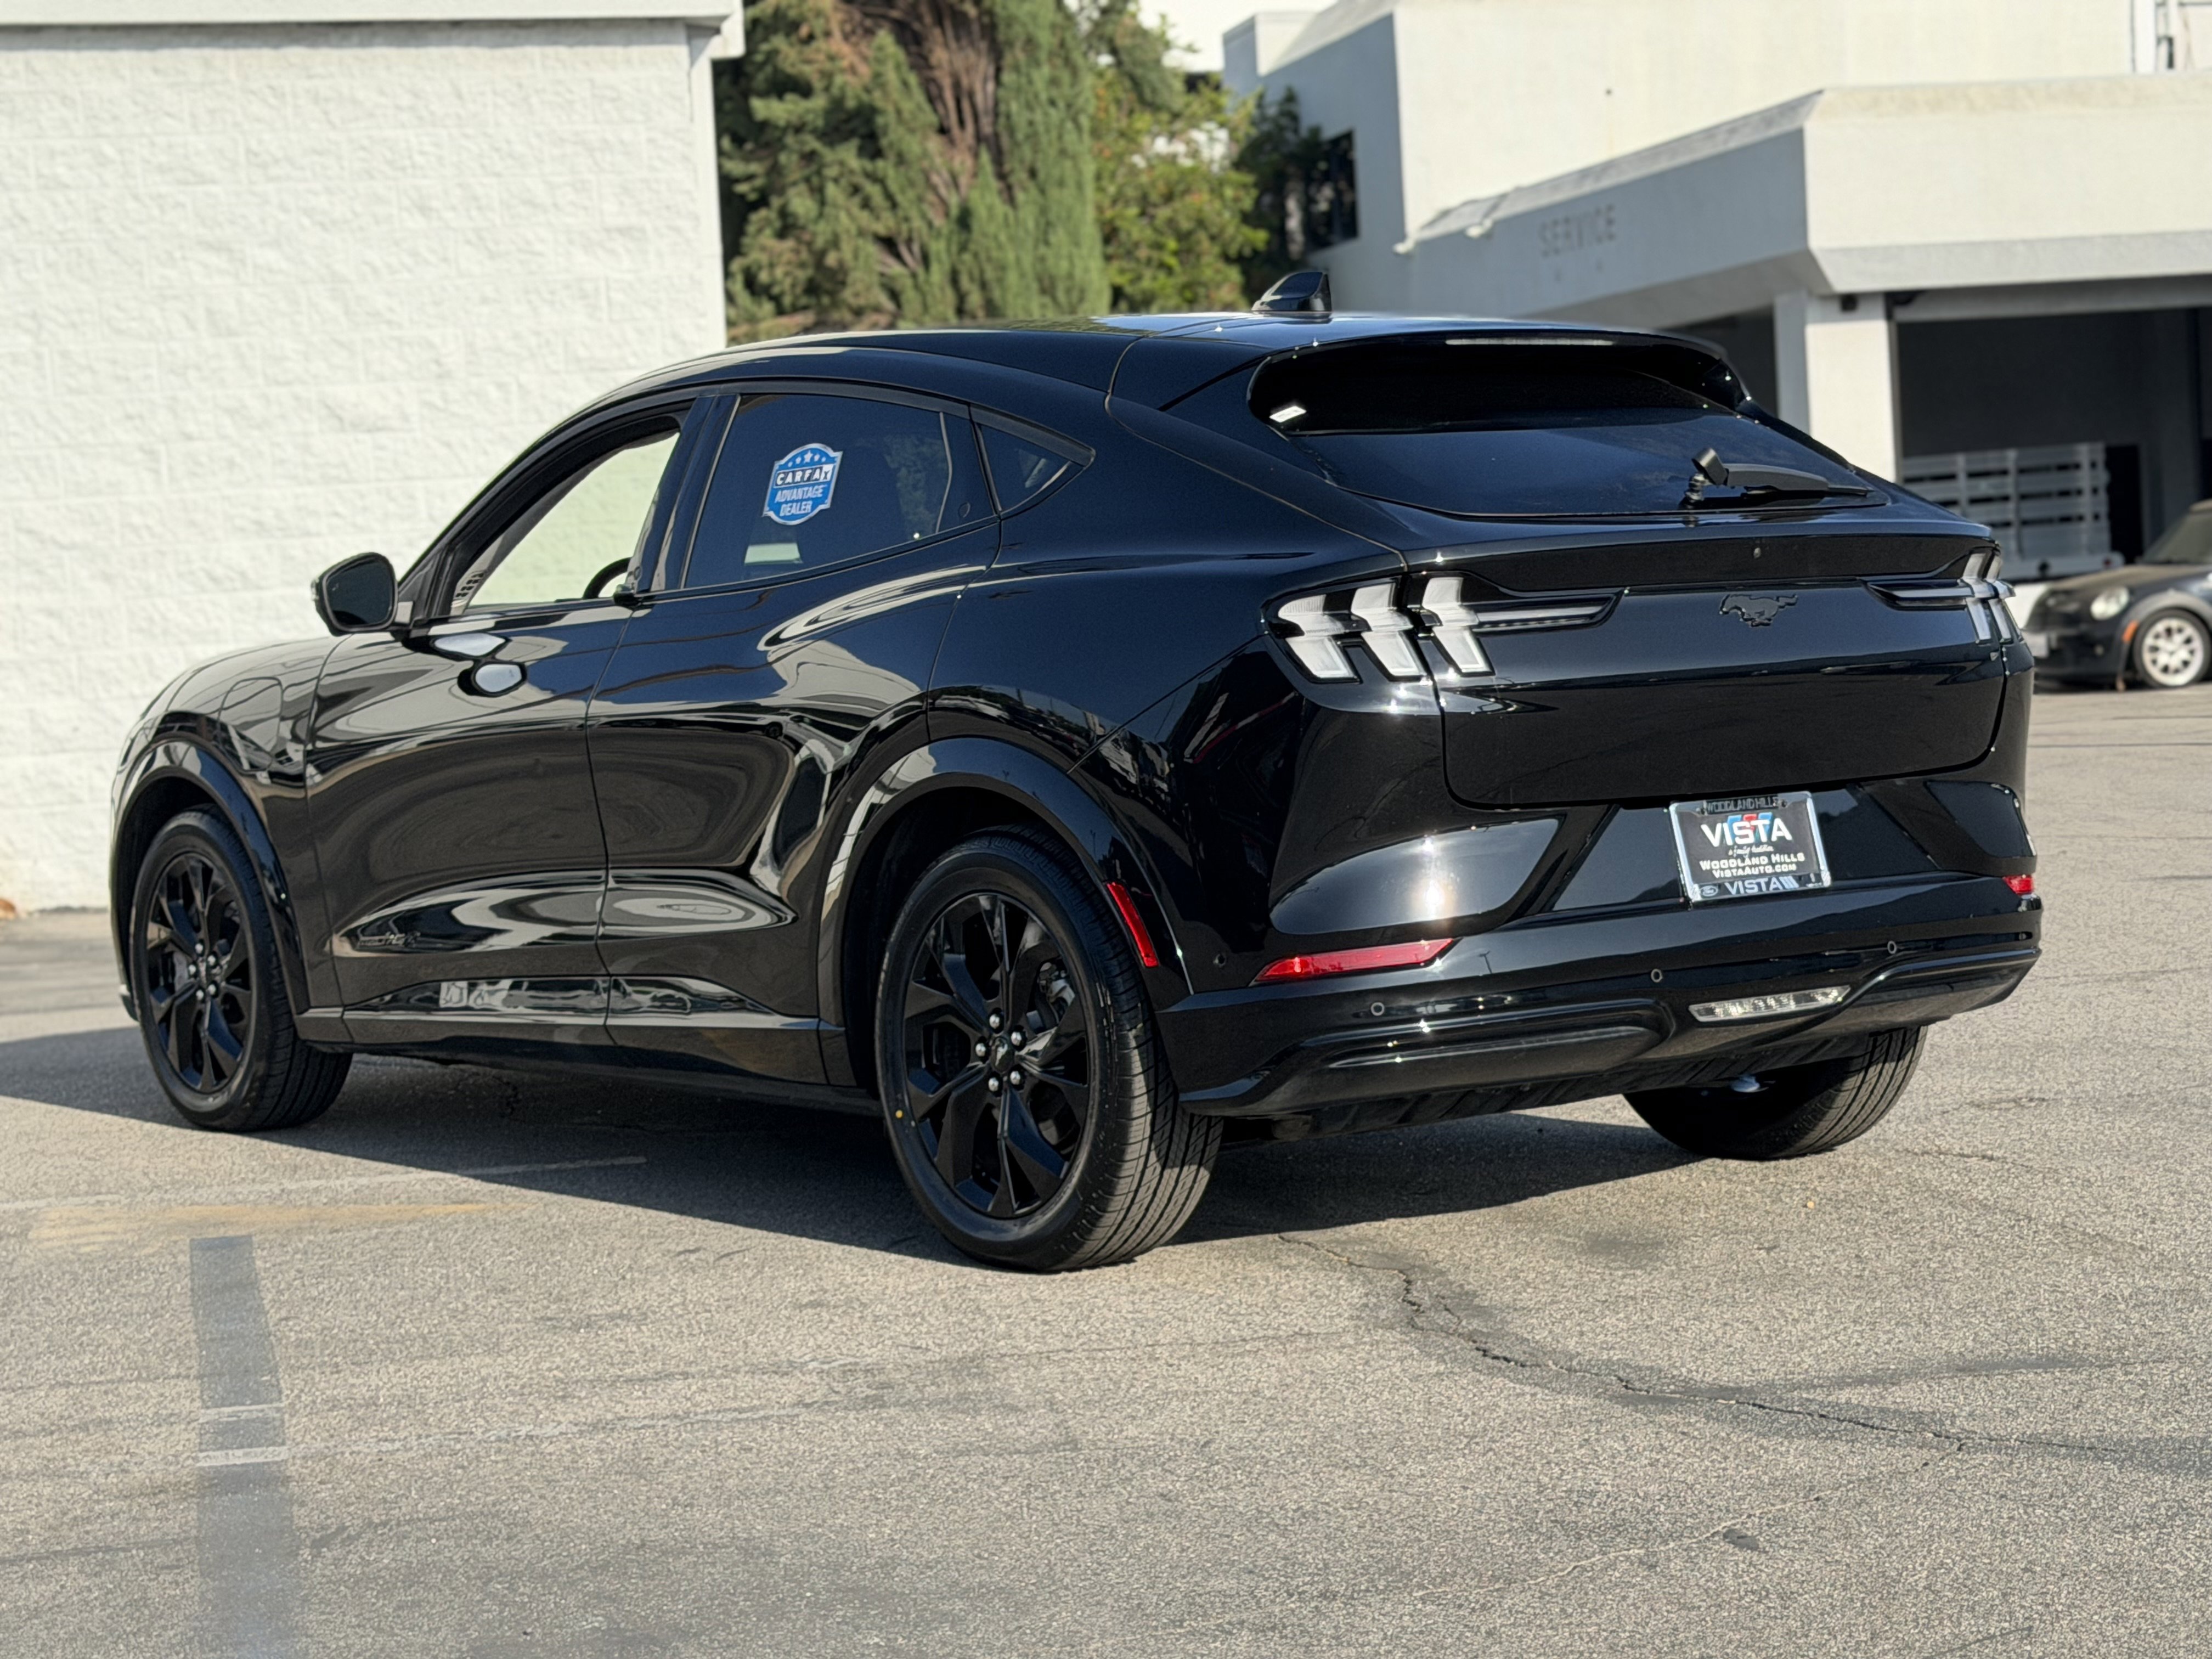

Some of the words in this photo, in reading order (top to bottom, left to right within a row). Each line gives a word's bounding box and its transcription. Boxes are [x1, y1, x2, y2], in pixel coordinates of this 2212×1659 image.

[1538, 203, 1616, 256] SERVICE
[776, 466, 832, 486] CARFAX
[775, 484, 827, 503] ADVANTAGE
[780, 501, 813, 517] DEALER
[1707, 798, 1754, 812] WOODLAND
[1701, 817, 1792, 847] VISTA
[1724, 877, 1782, 895] VISTA
